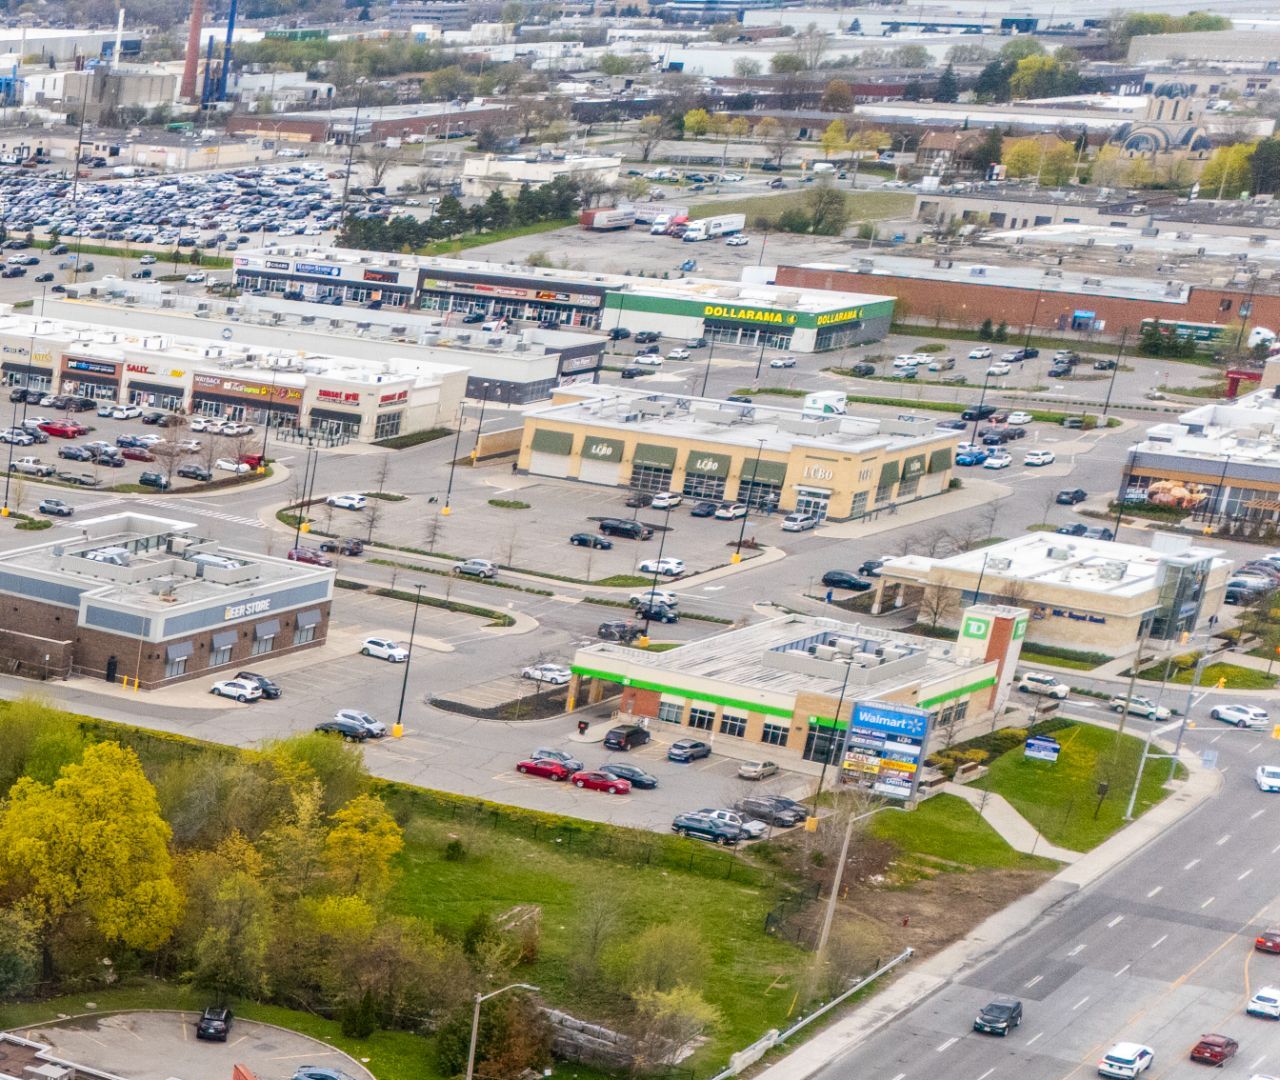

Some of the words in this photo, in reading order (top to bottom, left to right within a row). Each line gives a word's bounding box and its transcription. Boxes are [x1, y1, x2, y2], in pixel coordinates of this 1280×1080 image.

[704, 305, 783, 323] DOLLARAMA
[817, 308, 857, 325] DOLLARAMA
[127, 364, 148, 374] SALLY
[591, 444, 613, 456] LCBO
[696, 459, 719, 471] LCBO
[803, 464, 833, 481] LCBO
[246, 598, 271, 615] STORE
[967, 620, 986, 635] TD
[859, 711, 906, 729] Walmart
